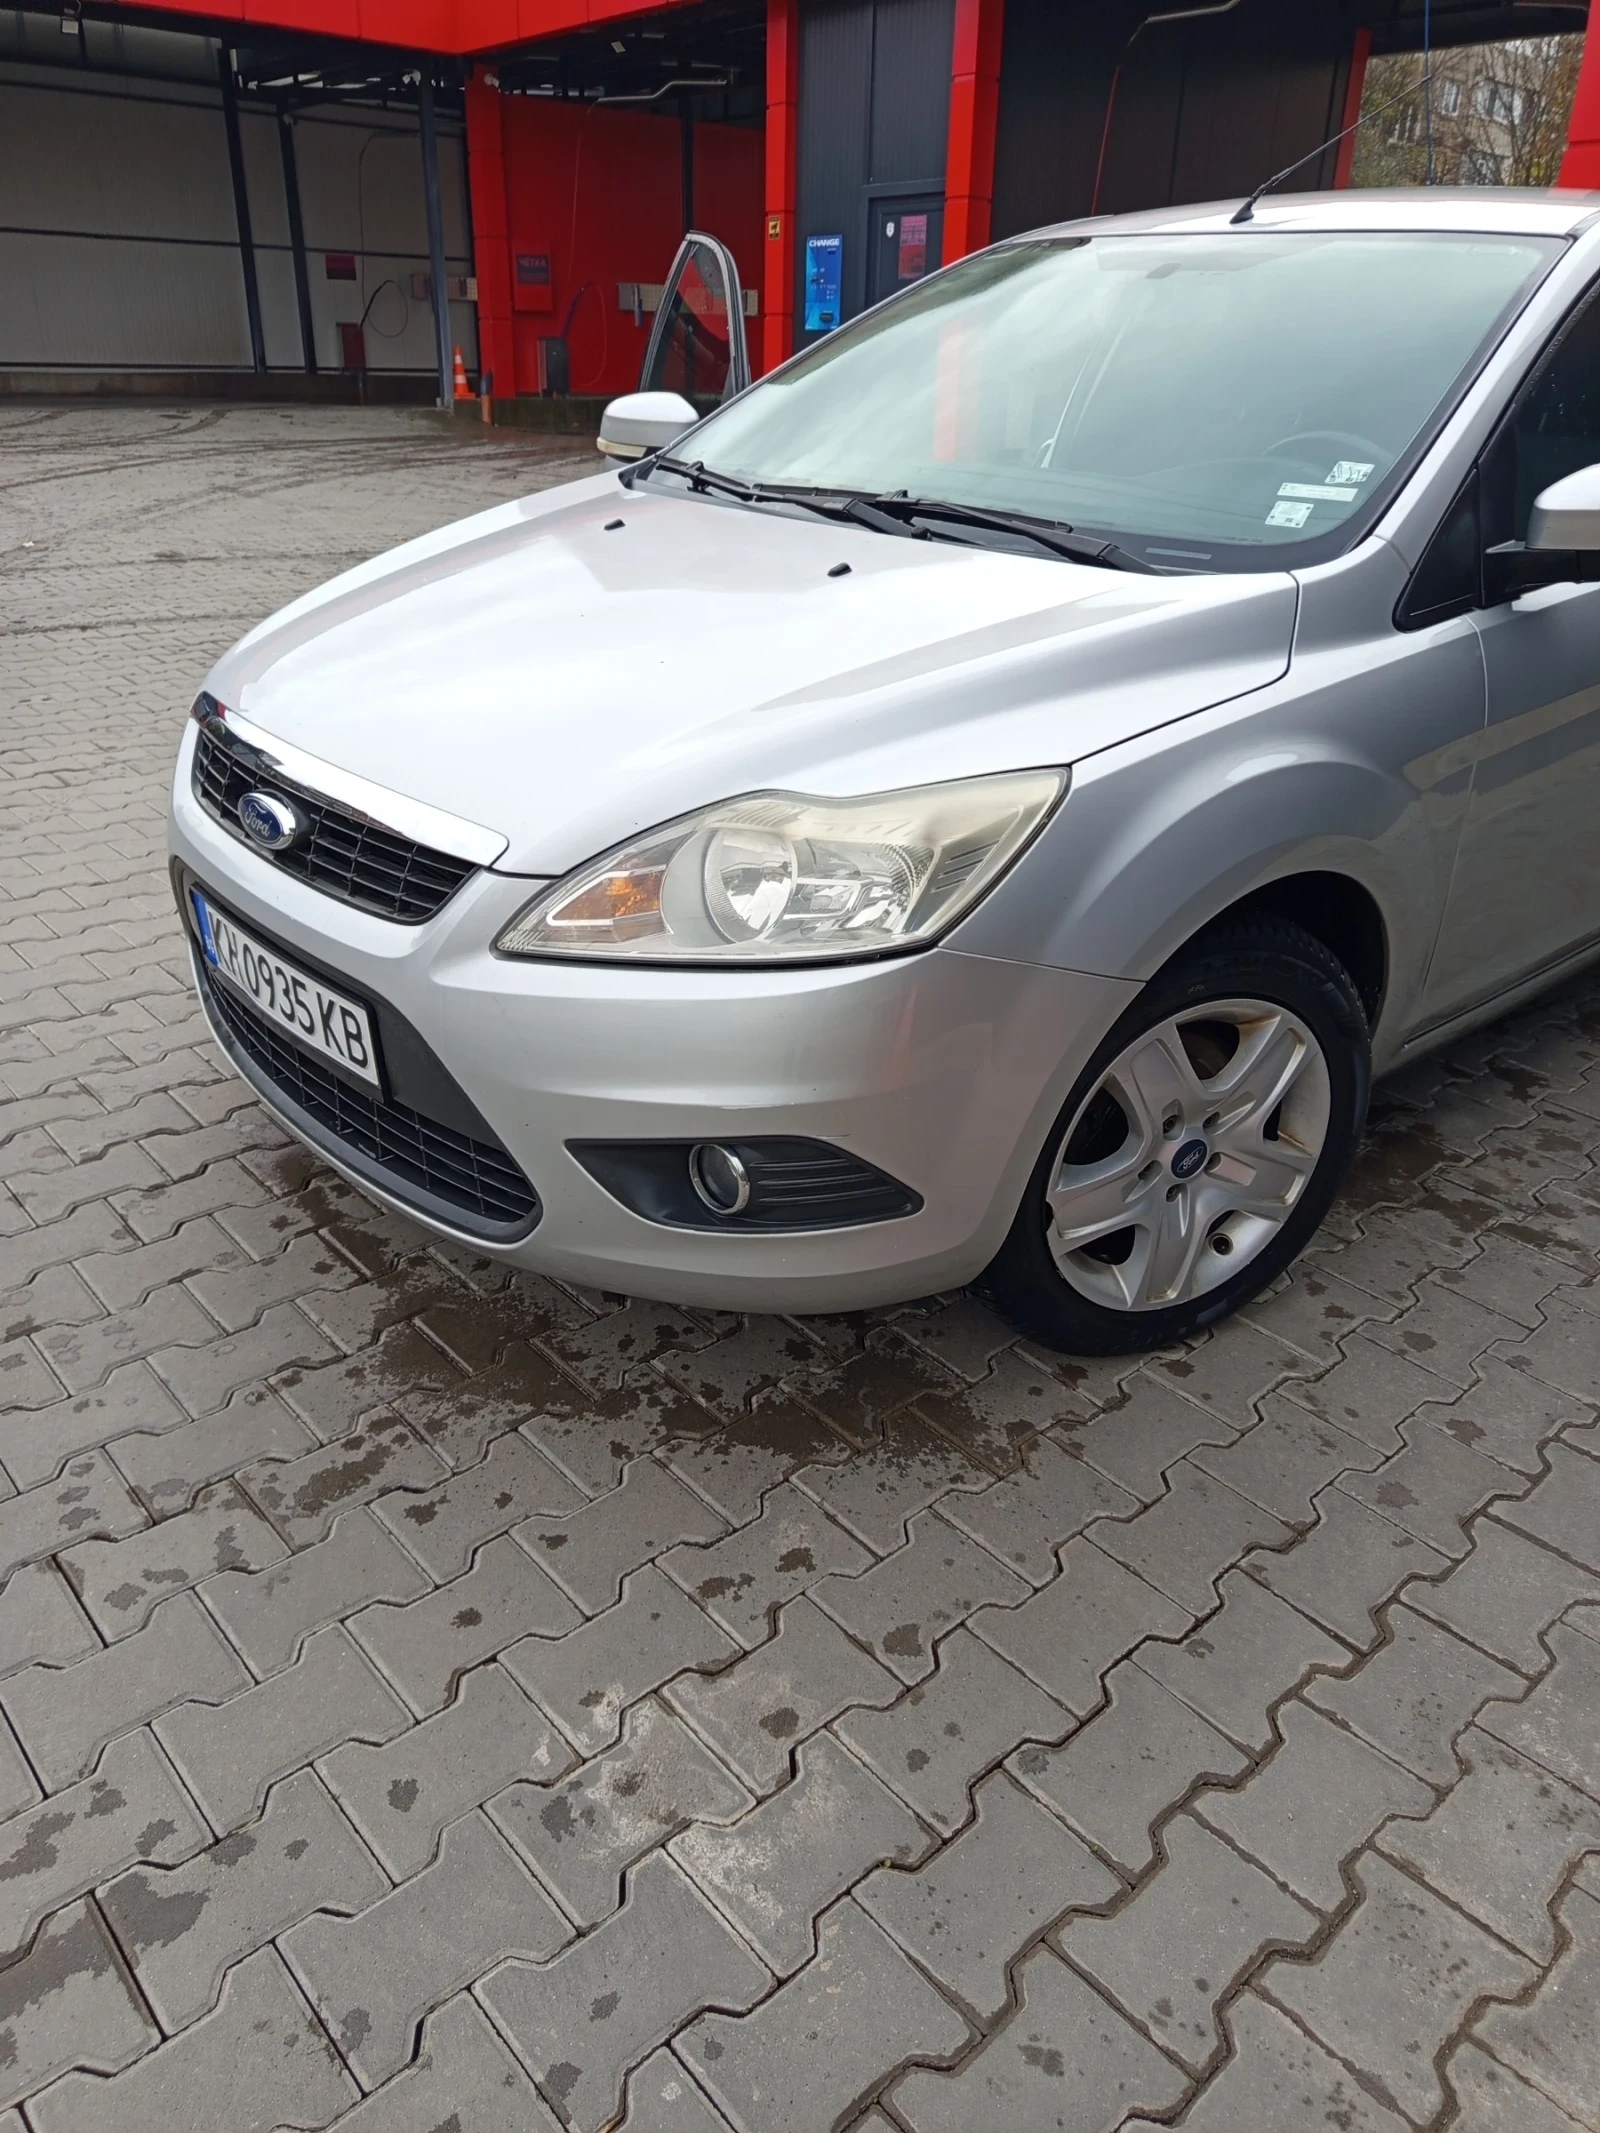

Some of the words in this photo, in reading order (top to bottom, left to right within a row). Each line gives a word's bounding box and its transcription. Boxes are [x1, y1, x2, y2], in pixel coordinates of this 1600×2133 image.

[808, 238, 840, 247] CHANGE
[518, 257, 547, 268] ЧЕТКА
[244, 802, 273, 837] Ford
